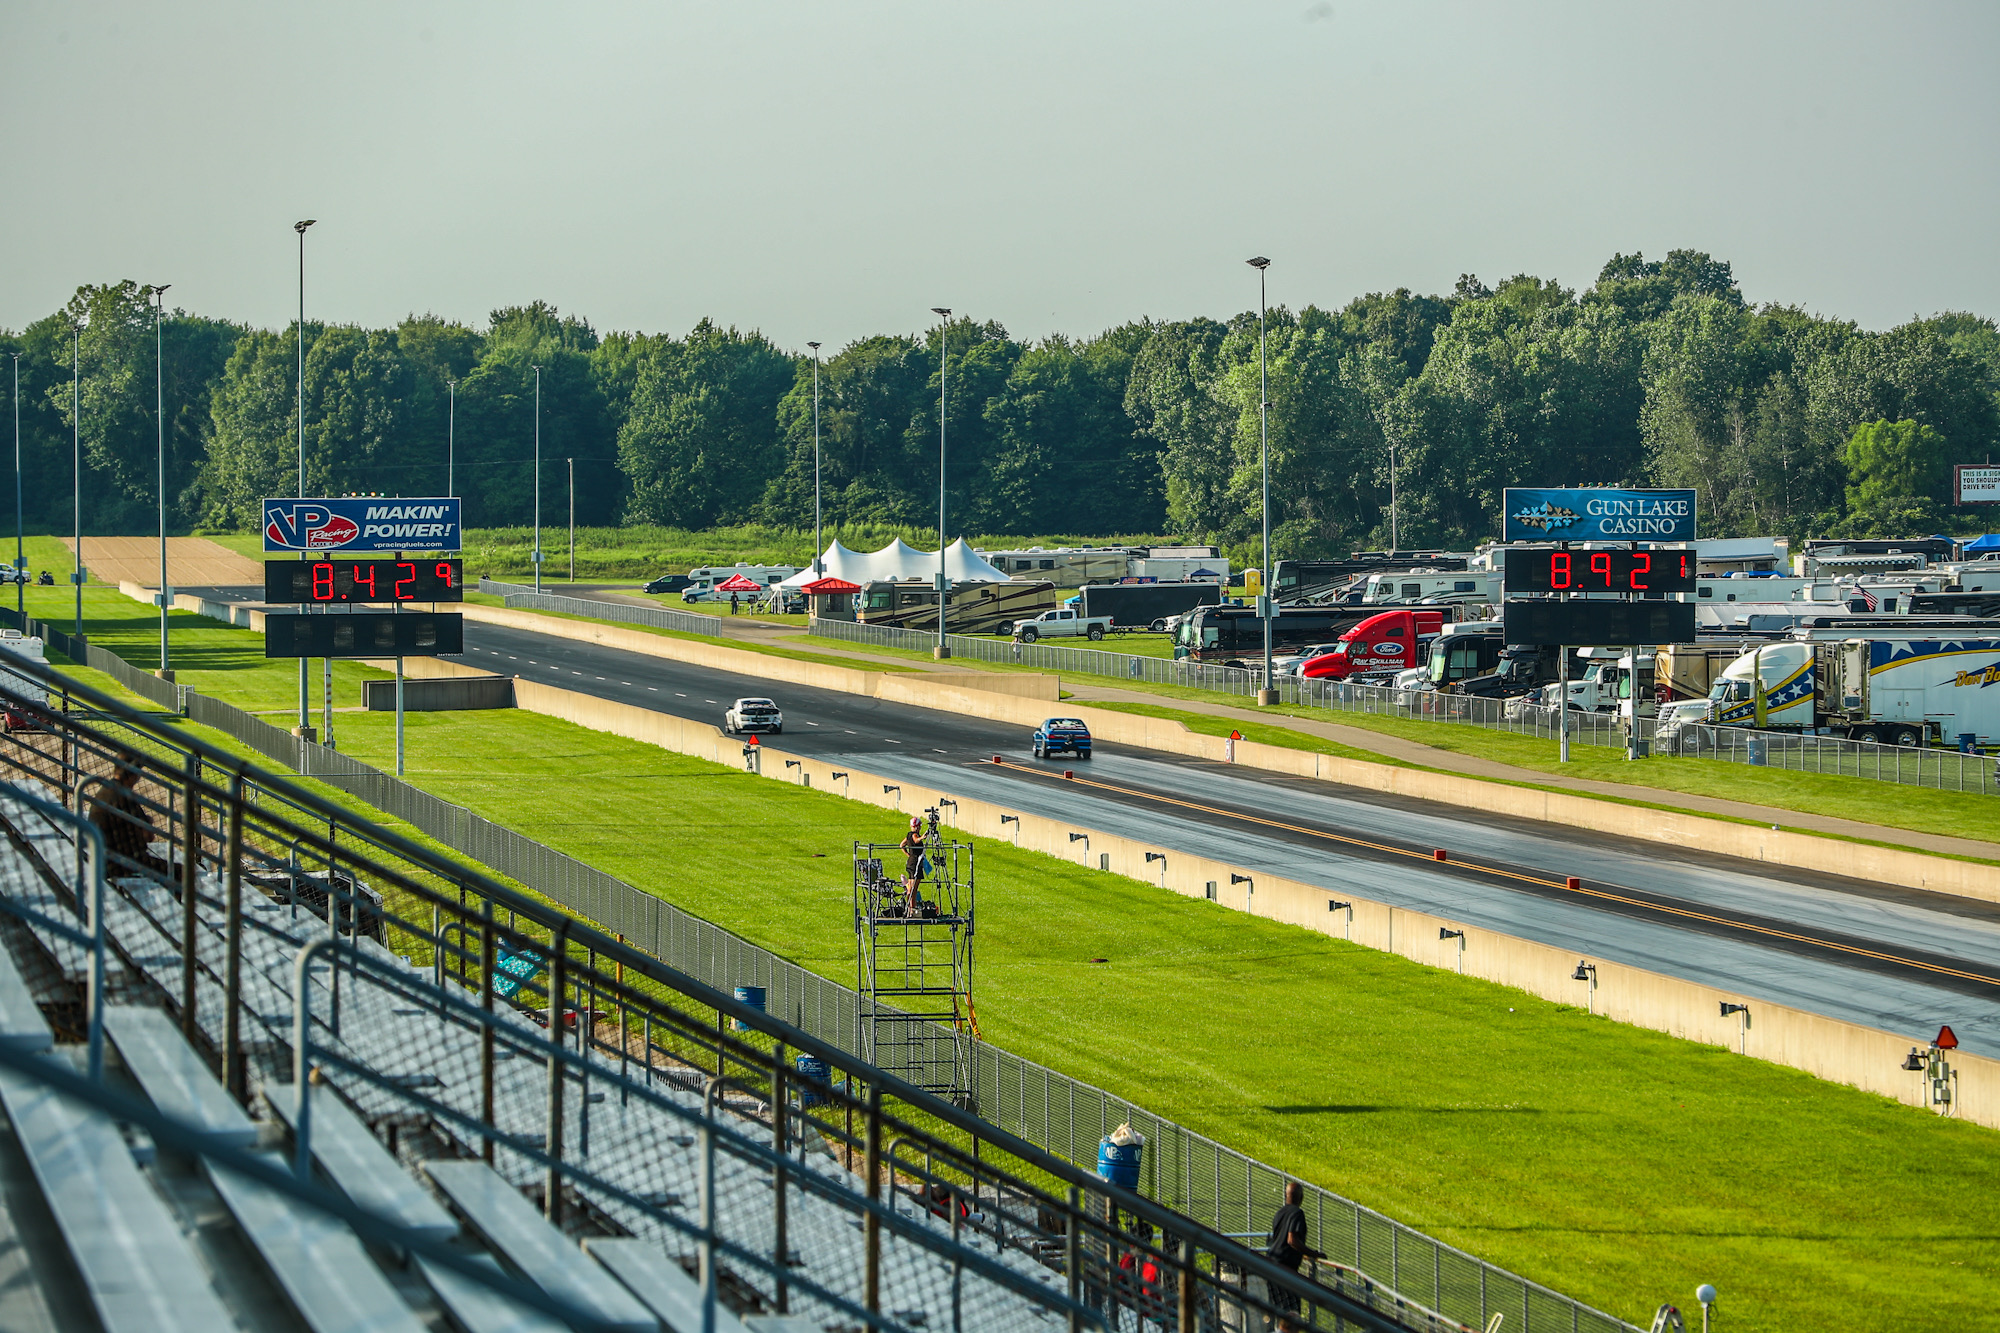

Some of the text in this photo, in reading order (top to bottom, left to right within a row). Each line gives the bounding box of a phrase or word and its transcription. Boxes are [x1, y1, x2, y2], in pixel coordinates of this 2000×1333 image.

[365, 505, 450, 520] MAKIN'
[1587, 499, 1689, 516] GUN LAKE
[268, 504, 331, 548] VP
[363, 523, 452, 538] POWER!
[1599, 518, 1676, 534] CASINO
[310, 528, 357, 541] Racing
[1380, 645, 1398, 653] Ford
[1352, 658, 1405, 666] RAY SKILLMAN
[1954, 670, 1983, 688] DON
